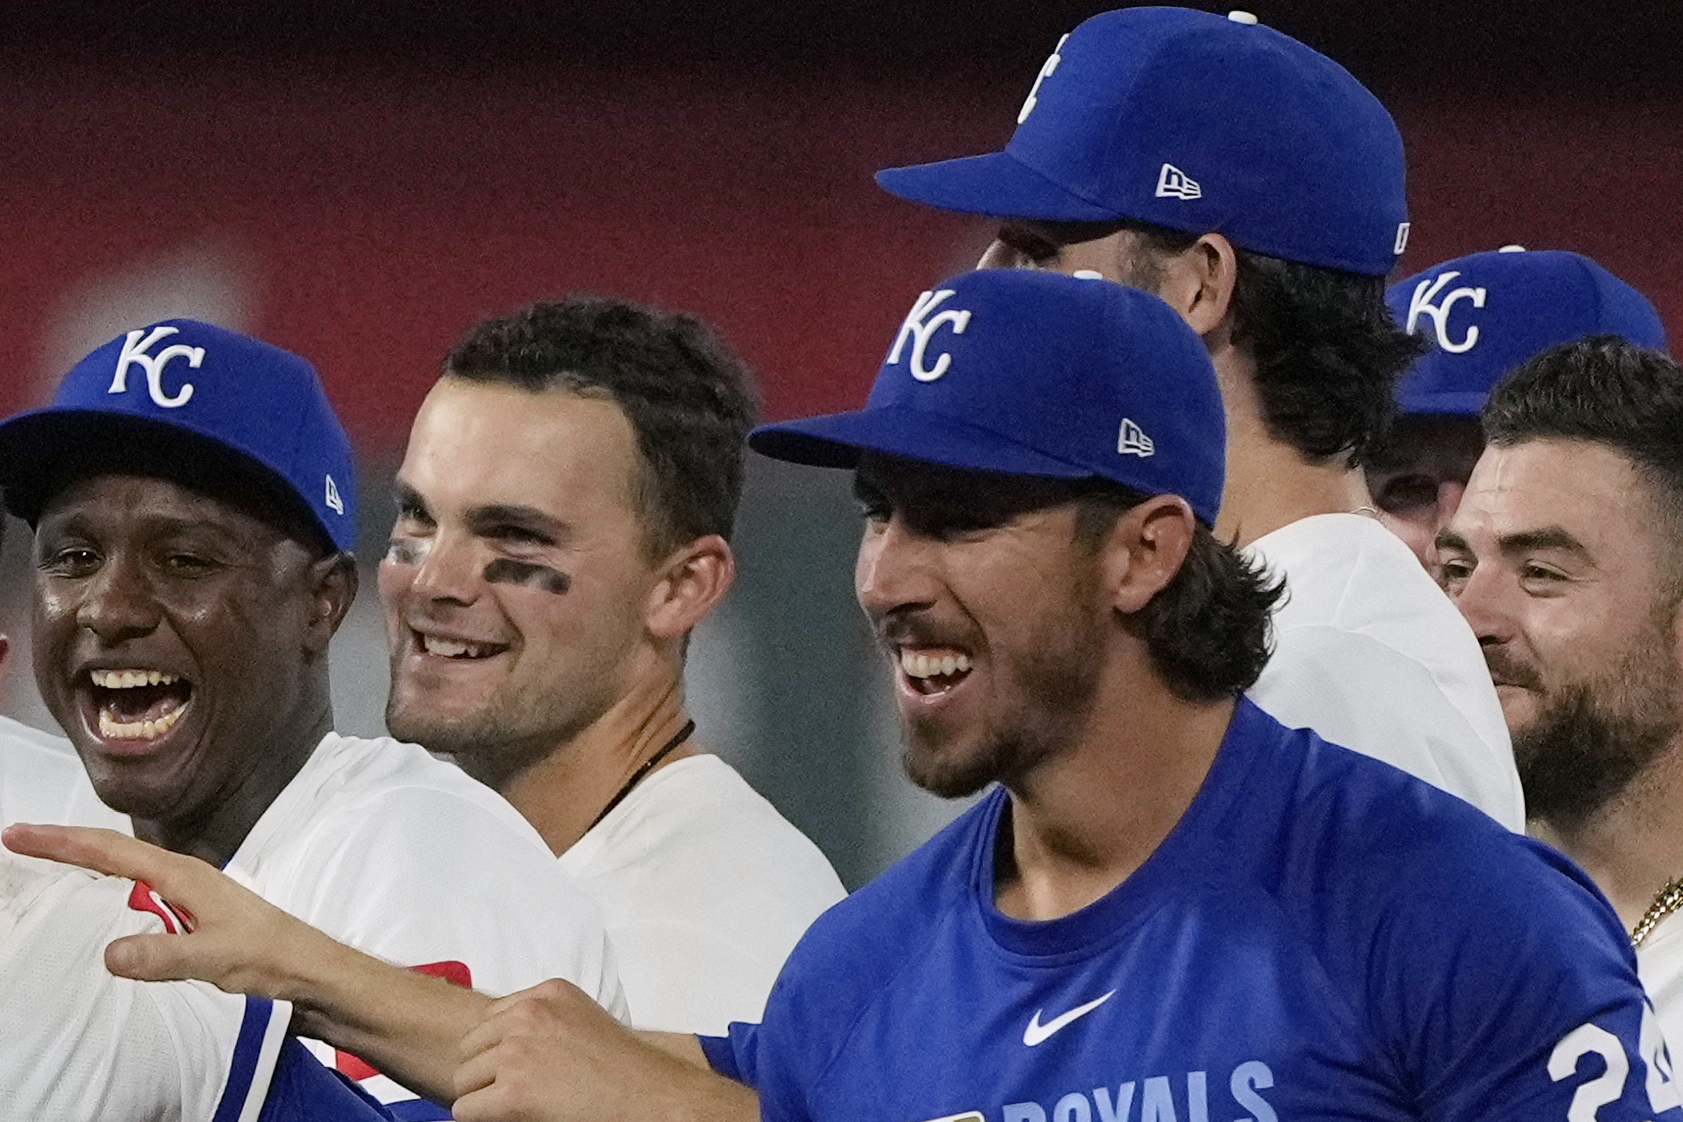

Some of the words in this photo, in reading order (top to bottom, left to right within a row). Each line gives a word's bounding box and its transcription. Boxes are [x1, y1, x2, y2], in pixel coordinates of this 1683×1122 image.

[885, 288, 972, 382] KC
[1405, 270, 1487, 354] KC
[108, 326, 206, 408] KC
